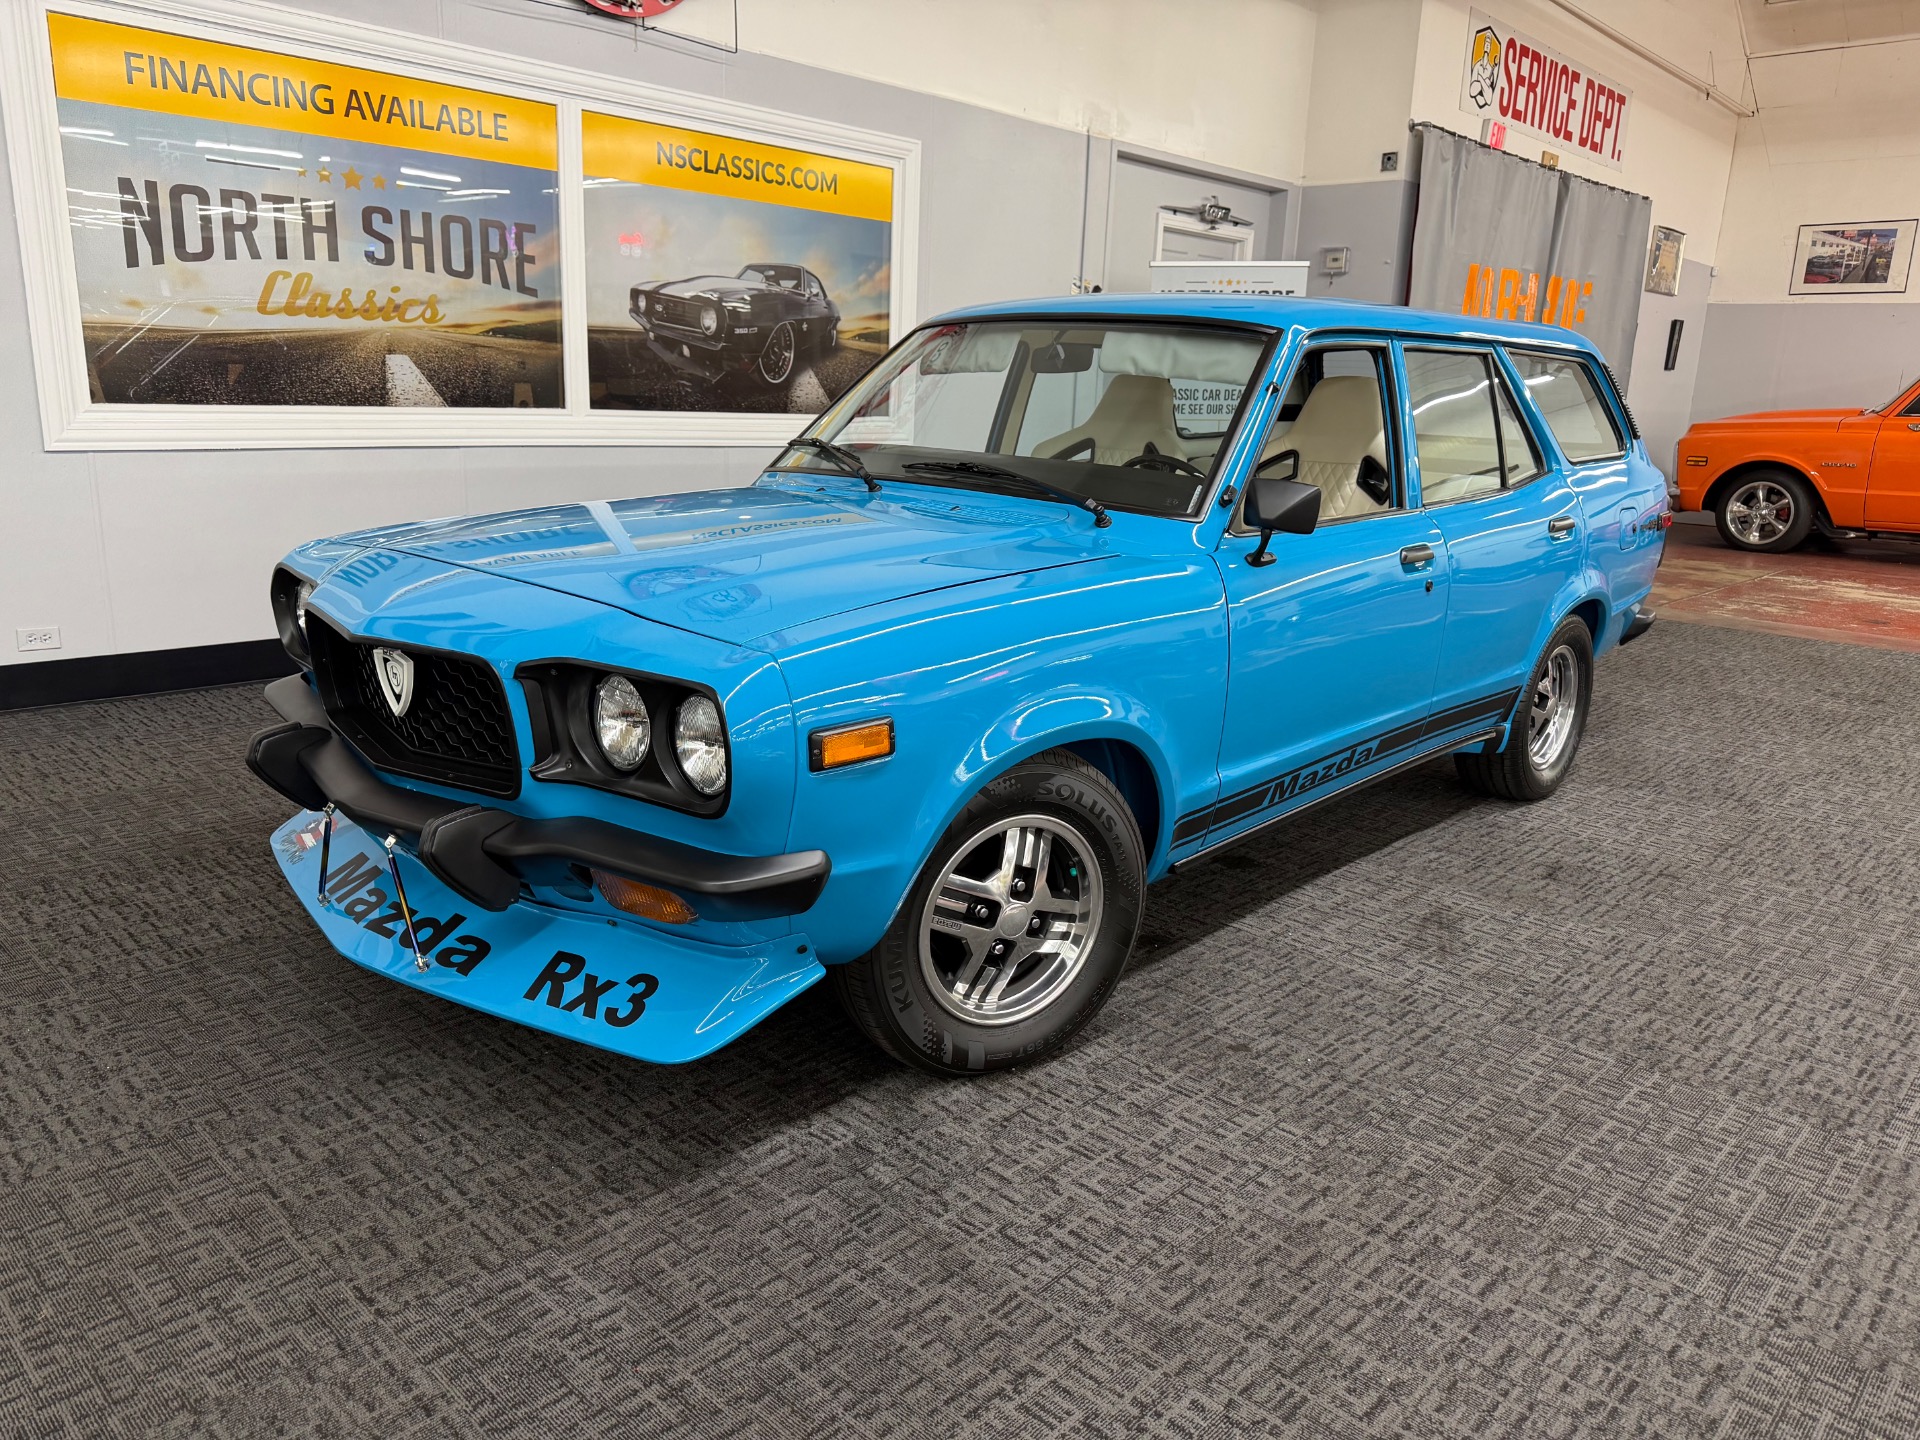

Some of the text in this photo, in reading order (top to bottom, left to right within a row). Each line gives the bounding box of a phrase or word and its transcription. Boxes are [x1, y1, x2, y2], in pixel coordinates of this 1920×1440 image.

[124, 51, 509, 142] FINANCING AVAILABLE
[1499, 37, 1626, 162] SERVICE DEPT.
[656, 141, 838, 195] NSCLASSICS.COM
[117, 177, 538, 298] NORTH SHORE
[256, 270, 446, 325] Classics
[1188, 403, 1204, 415] SEE
[1206, 403, 1223, 415] OUR
[1202, 388, 1221, 401] CAR
[1268, 747, 1372, 804] Mazda
[1037, 782, 1118, 833] SOLUS
[325, 852, 659, 1028] Mazda Rx3
